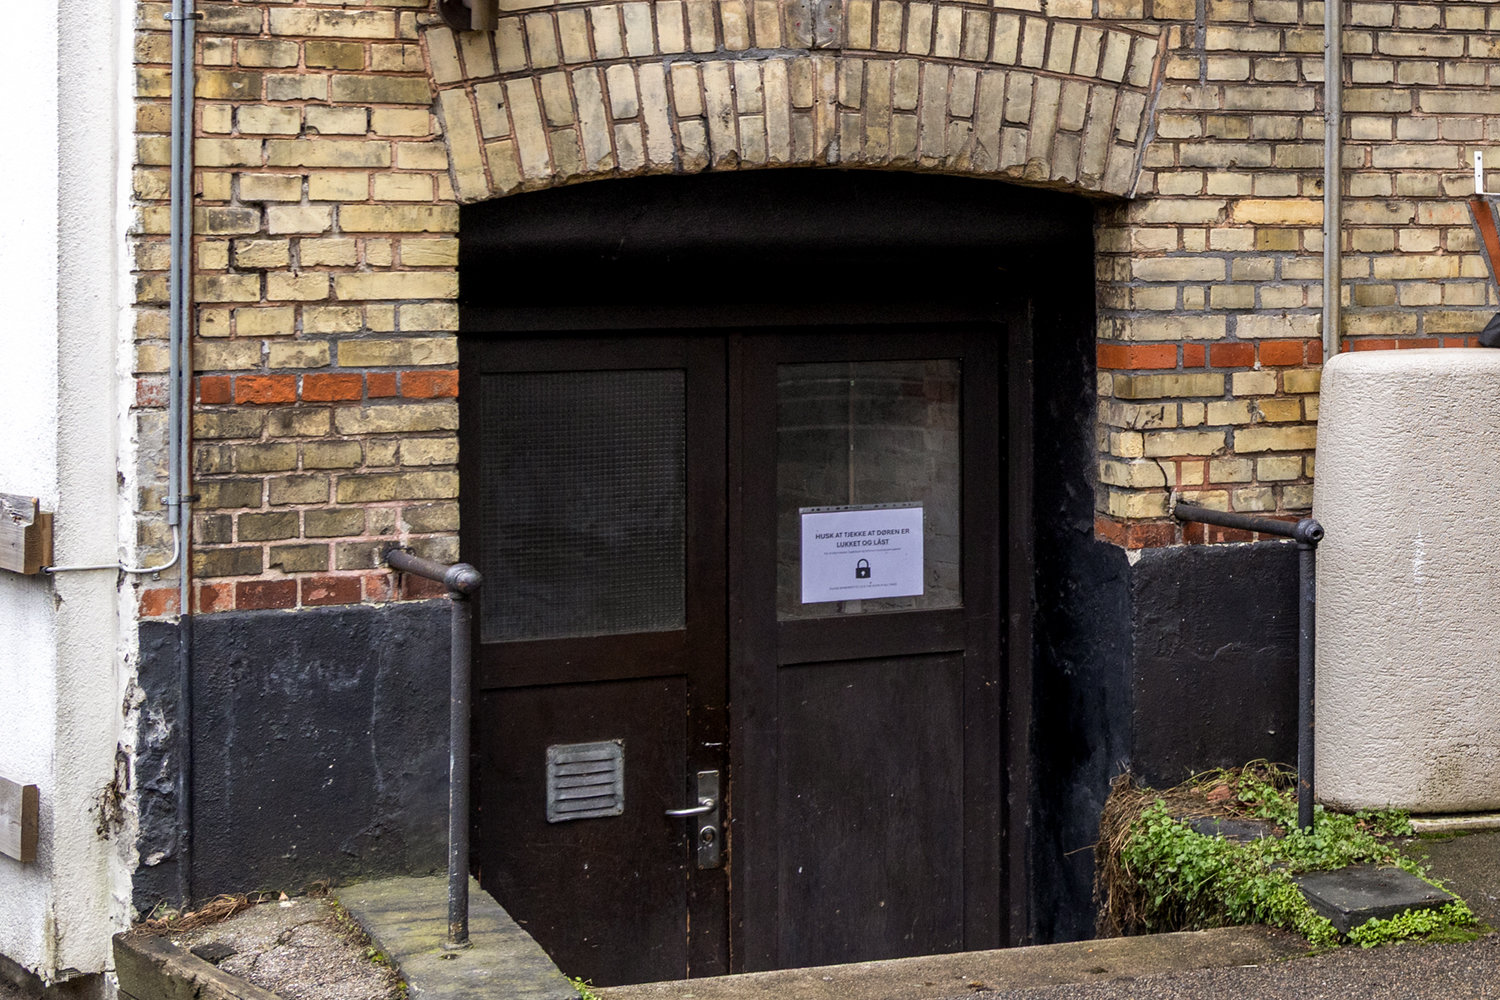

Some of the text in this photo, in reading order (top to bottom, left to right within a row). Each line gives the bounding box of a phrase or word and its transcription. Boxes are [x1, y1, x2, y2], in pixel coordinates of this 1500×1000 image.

[815, 532, 834, 540] HUSK
[836, 540, 860, 548] LUKKET
[873, 538, 889, 546] LÅST
